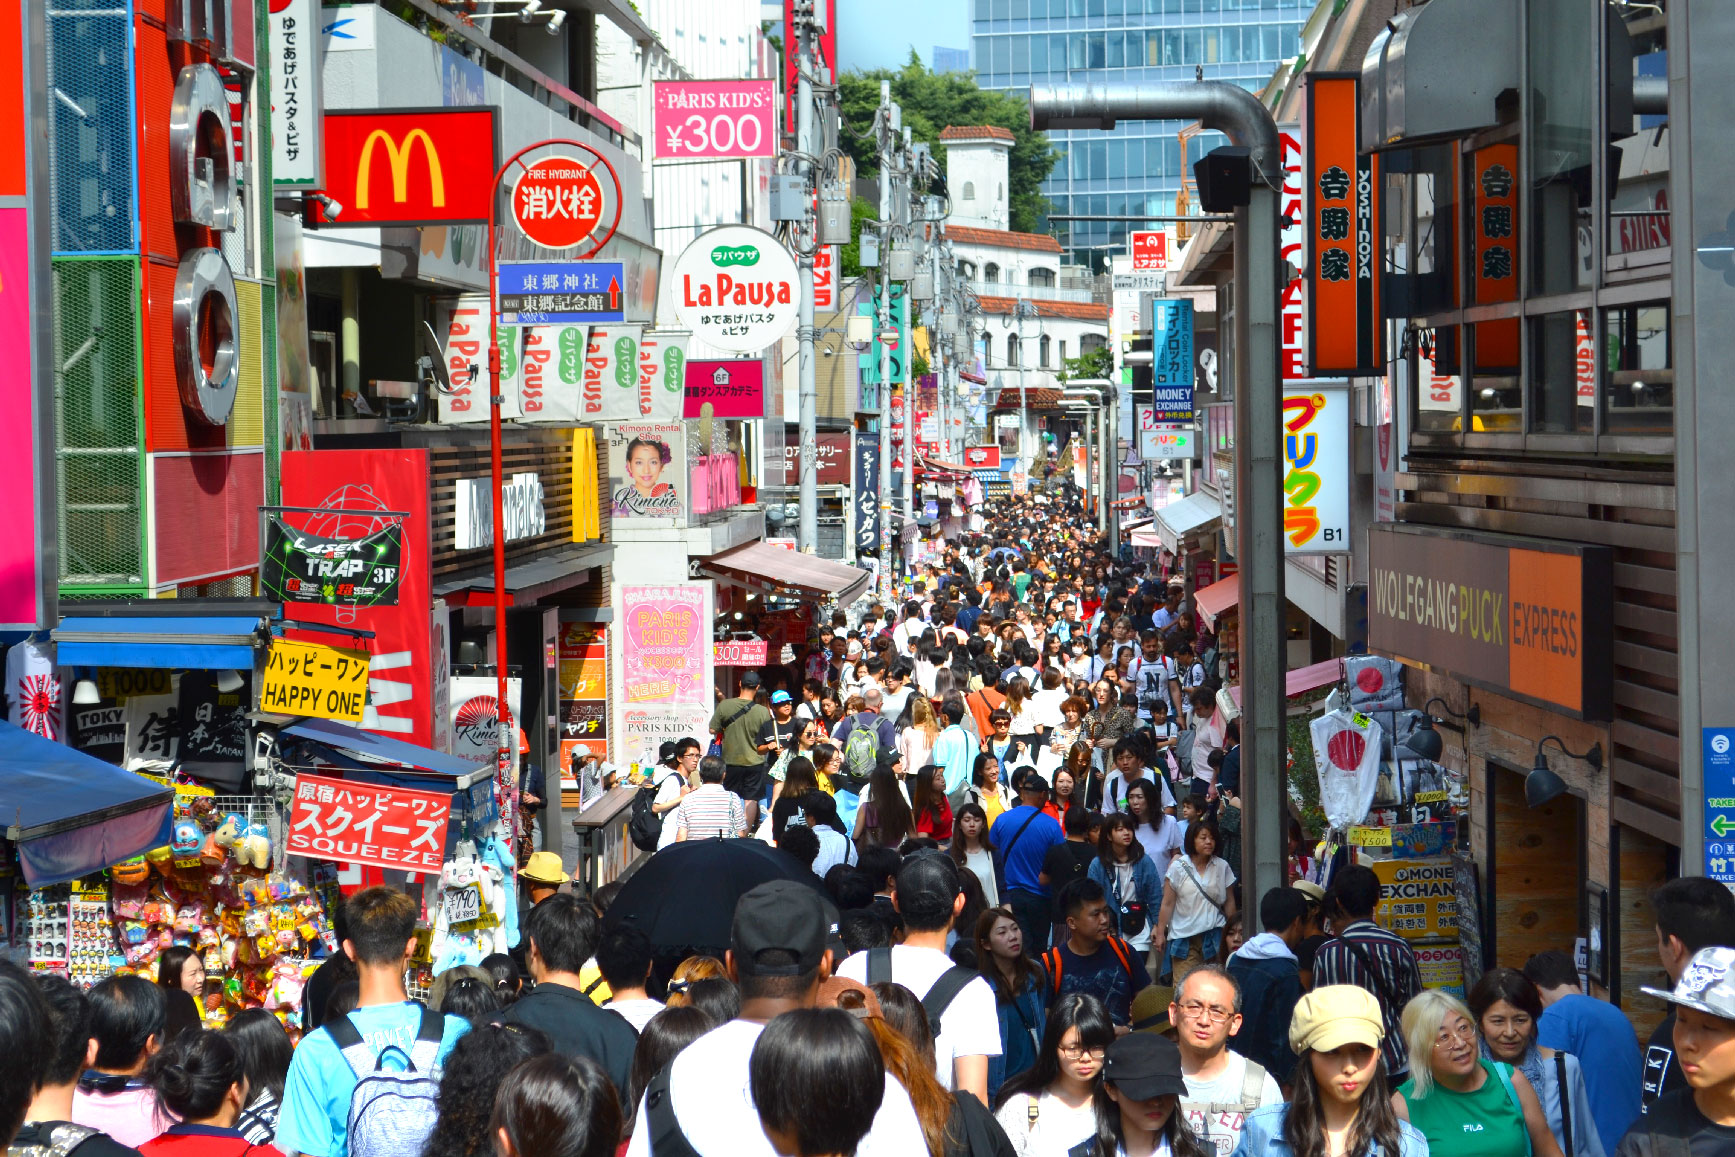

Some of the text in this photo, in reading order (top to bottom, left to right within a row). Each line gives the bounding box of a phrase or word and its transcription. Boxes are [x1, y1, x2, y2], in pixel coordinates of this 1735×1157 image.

[668, 88, 763, 109] PARIS KID'S
[666, 114, 762, 153] ¥300
[528, 169, 588, 180] FIRE HYDRANT
[521, 185, 596, 220] 消火栓
[1319, 166, 1350, 282] 吉野家
[711, 250, 759, 261] ラパウザ
[521, 273, 599, 291] 東郷神社
[684, 272, 791, 309] La Pausa
[521, 294, 604, 312] 東郷記念館
[701, 313, 775, 325] ゆであげパスタ
[722, 326, 749, 336] &ピザ
[1167, 305, 1180, 383] コインロッカー
[522, 350, 551, 412] Pausa
[715, 373, 728, 383] 6F
[1156, 389, 1192, 400] MONEY
[1156, 402, 1192, 411] EXCHANGE
[619, 425, 652, 433] Kimono
[639, 433, 661, 442] Shop
[614, 486, 680, 515] Kimono
[1323, 528, 1342, 541] B1
[306, 558, 364, 578] TRAP
[373, 568, 395, 583] 3F
[1374, 568, 1503, 646] WOLFGANG PUCK
[638, 611, 692, 628] PARIS
[642, 629, 688, 646] KID'S
[1513, 602, 1578, 658] EXPRESS
[269, 651, 366, 682] ハッピーワン
[265, 682, 362, 717] HAPPY ONE
[628, 723, 694, 732] PARIS KID'S
[215, 743, 244, 757] JAPAN
[297, 781, 447, 817] 原宿ハッピーワン
[293, 802, 446, 852] スクイーズ
[290, 834, 441, 867] SQUEEZE
[1463, 1123, 1484, 1133] FILA
